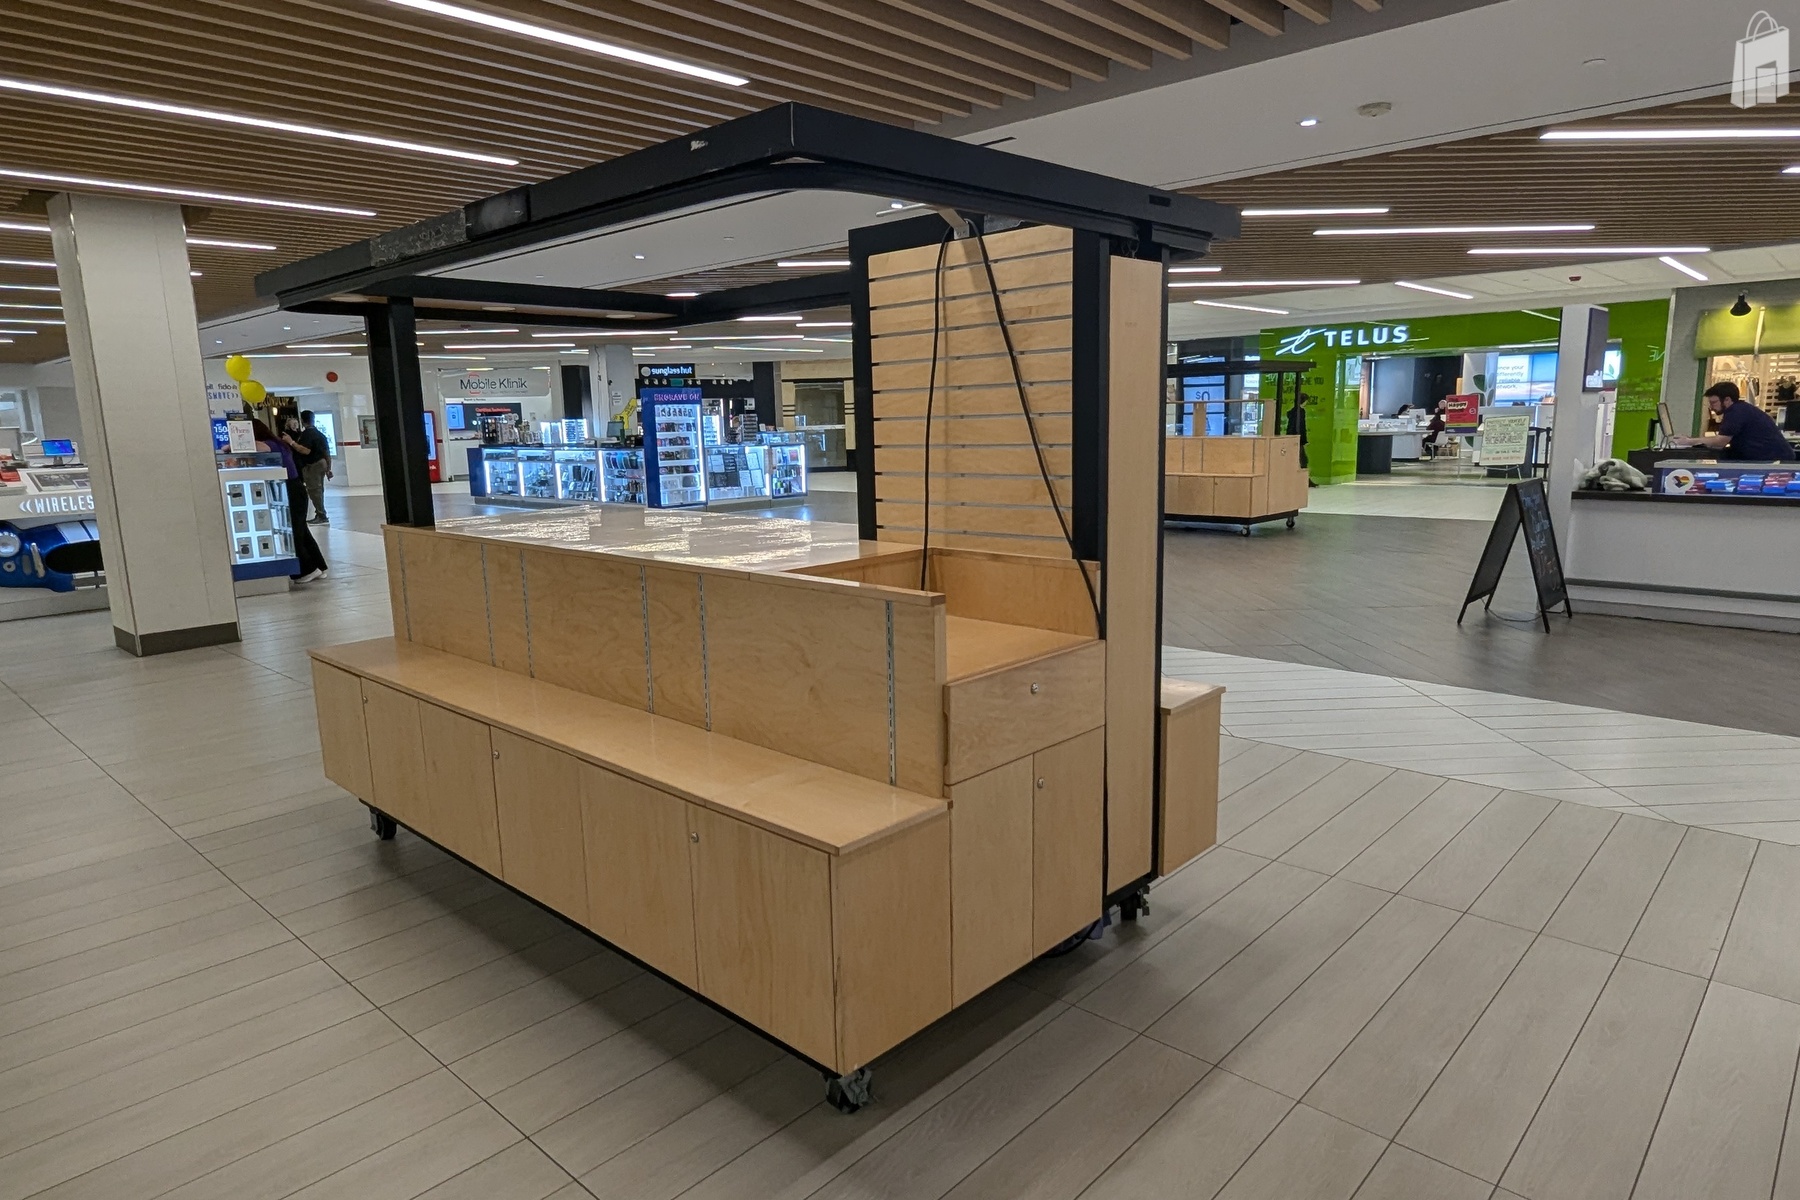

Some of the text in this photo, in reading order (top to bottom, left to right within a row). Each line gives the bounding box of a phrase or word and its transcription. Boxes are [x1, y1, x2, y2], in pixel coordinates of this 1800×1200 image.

[1324, 326, 1408, 347] TELUS
[651, 366, 693, 376] sunglass hut
[460, 377, 528, 390] Mobile Klinik
